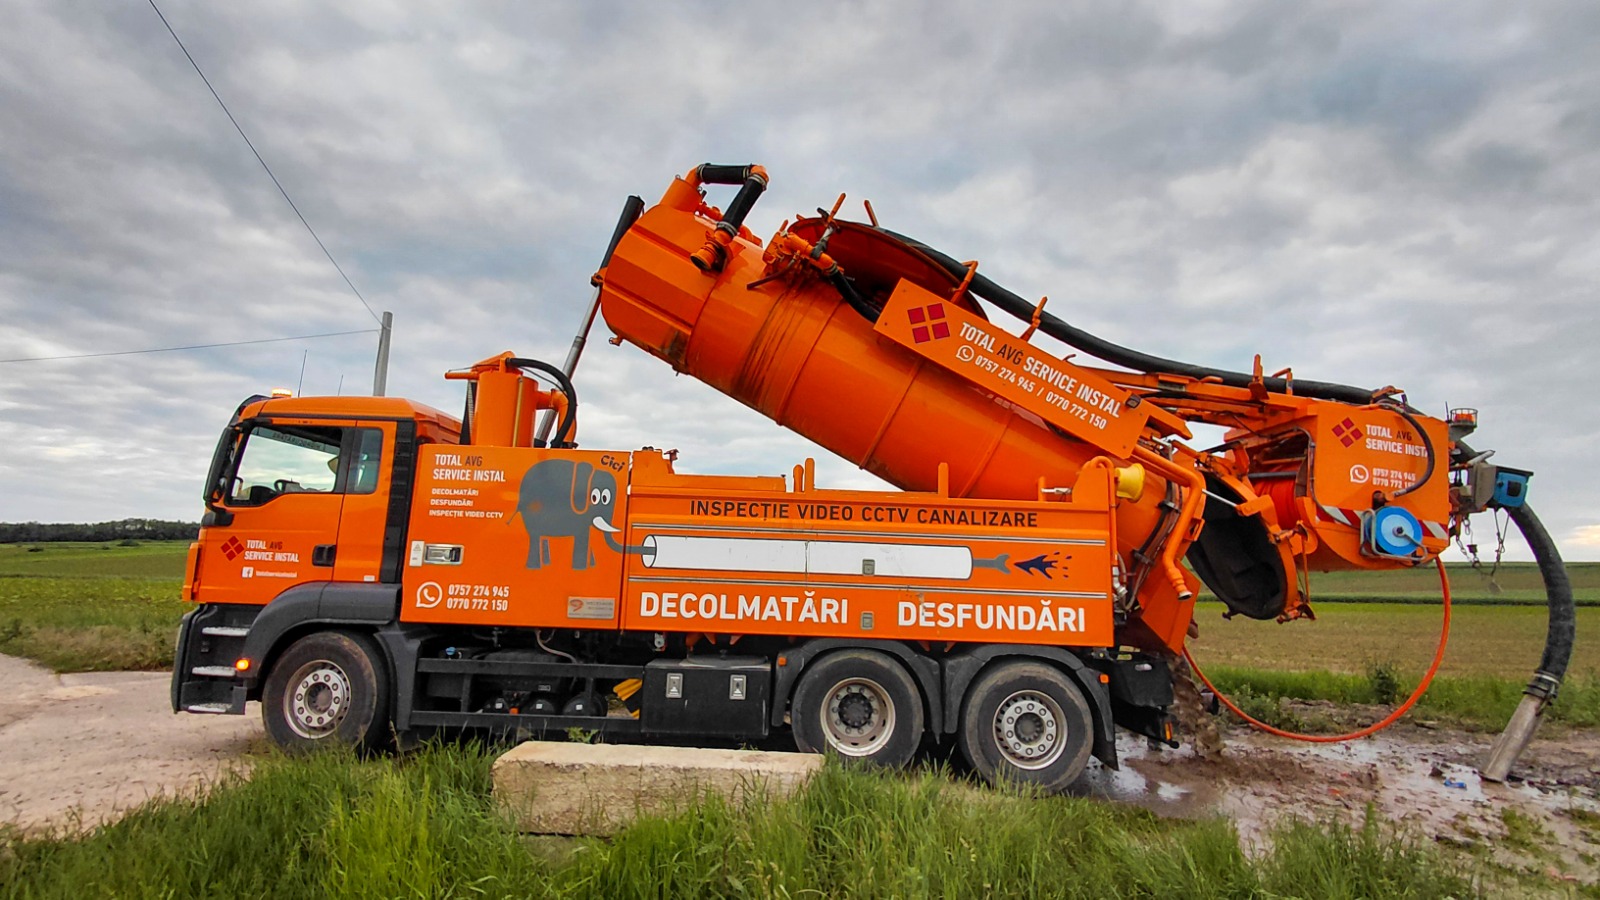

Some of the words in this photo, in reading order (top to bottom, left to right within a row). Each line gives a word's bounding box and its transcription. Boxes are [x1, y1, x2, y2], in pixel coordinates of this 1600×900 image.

[959, 322, 996, 353] TOTAL
[997, 343, 1025, 366] AVG
[1022, 356, 1077, 394] SERVICE
[1076, 383, 1122, 419] INSTAL
[975, 355, 1000, 374] 0757
[998, 367, 1016, 383] 274
[1017, 376, 1036, 393] 945
[1036, 387, 1044, 397] /
[1045, 391, 1071, 411] 0770
[1070, 403, 1092, 420] 772
[1088, 413, 1107, 430] 150
[1366, 424, 1392, 438] TOTAL
[1396, 430, 1412, 441] AVG
[1366, 438, 1402, 453] SERVICE
[1405, 444, 1428, 457] INST
[435, 454, 462, 467] TOTAL
[464, 456, 483, 467] AVG
[600, 454, 625, 472] Cici
[433, 468, 471, 481] SERVICE
[473, 470, 506, 482] INSTAL
[1373, 468, 1388, 477] 0757
[1390, 470, 1402, 479] 274
[1403, 472, 1416, 482] 945
[1373, 477, 1388, 487] 0770
[1390, 479, 1402, 489] 772
[465, 510, 485, 518] VIDEO
[797, 504, 853, 520] VIDEO
[861, 506, 910, 523] CCTV
[917, 508, 1038, 528] CANALIZARE
[246, 539, 267, 550] TOTAL
[269, 541, 283, 550] AVG
[244, 551, 273, 562] SERVICE
[274, 553, 299, 563] INSTAL
[448, 584, 471, 596] 0757
[473, 585, 490, 597] 274
[492, 586, 510, 598] 945
[446, 597, 470, 610] 0770
[472, 598, 488, 610] 772
[491, 599, 508, 611] 150
[640, 590, 848, 624] DECOLMATĂRI
[898, 599, 1085, 632] DESFUNDĂRI
